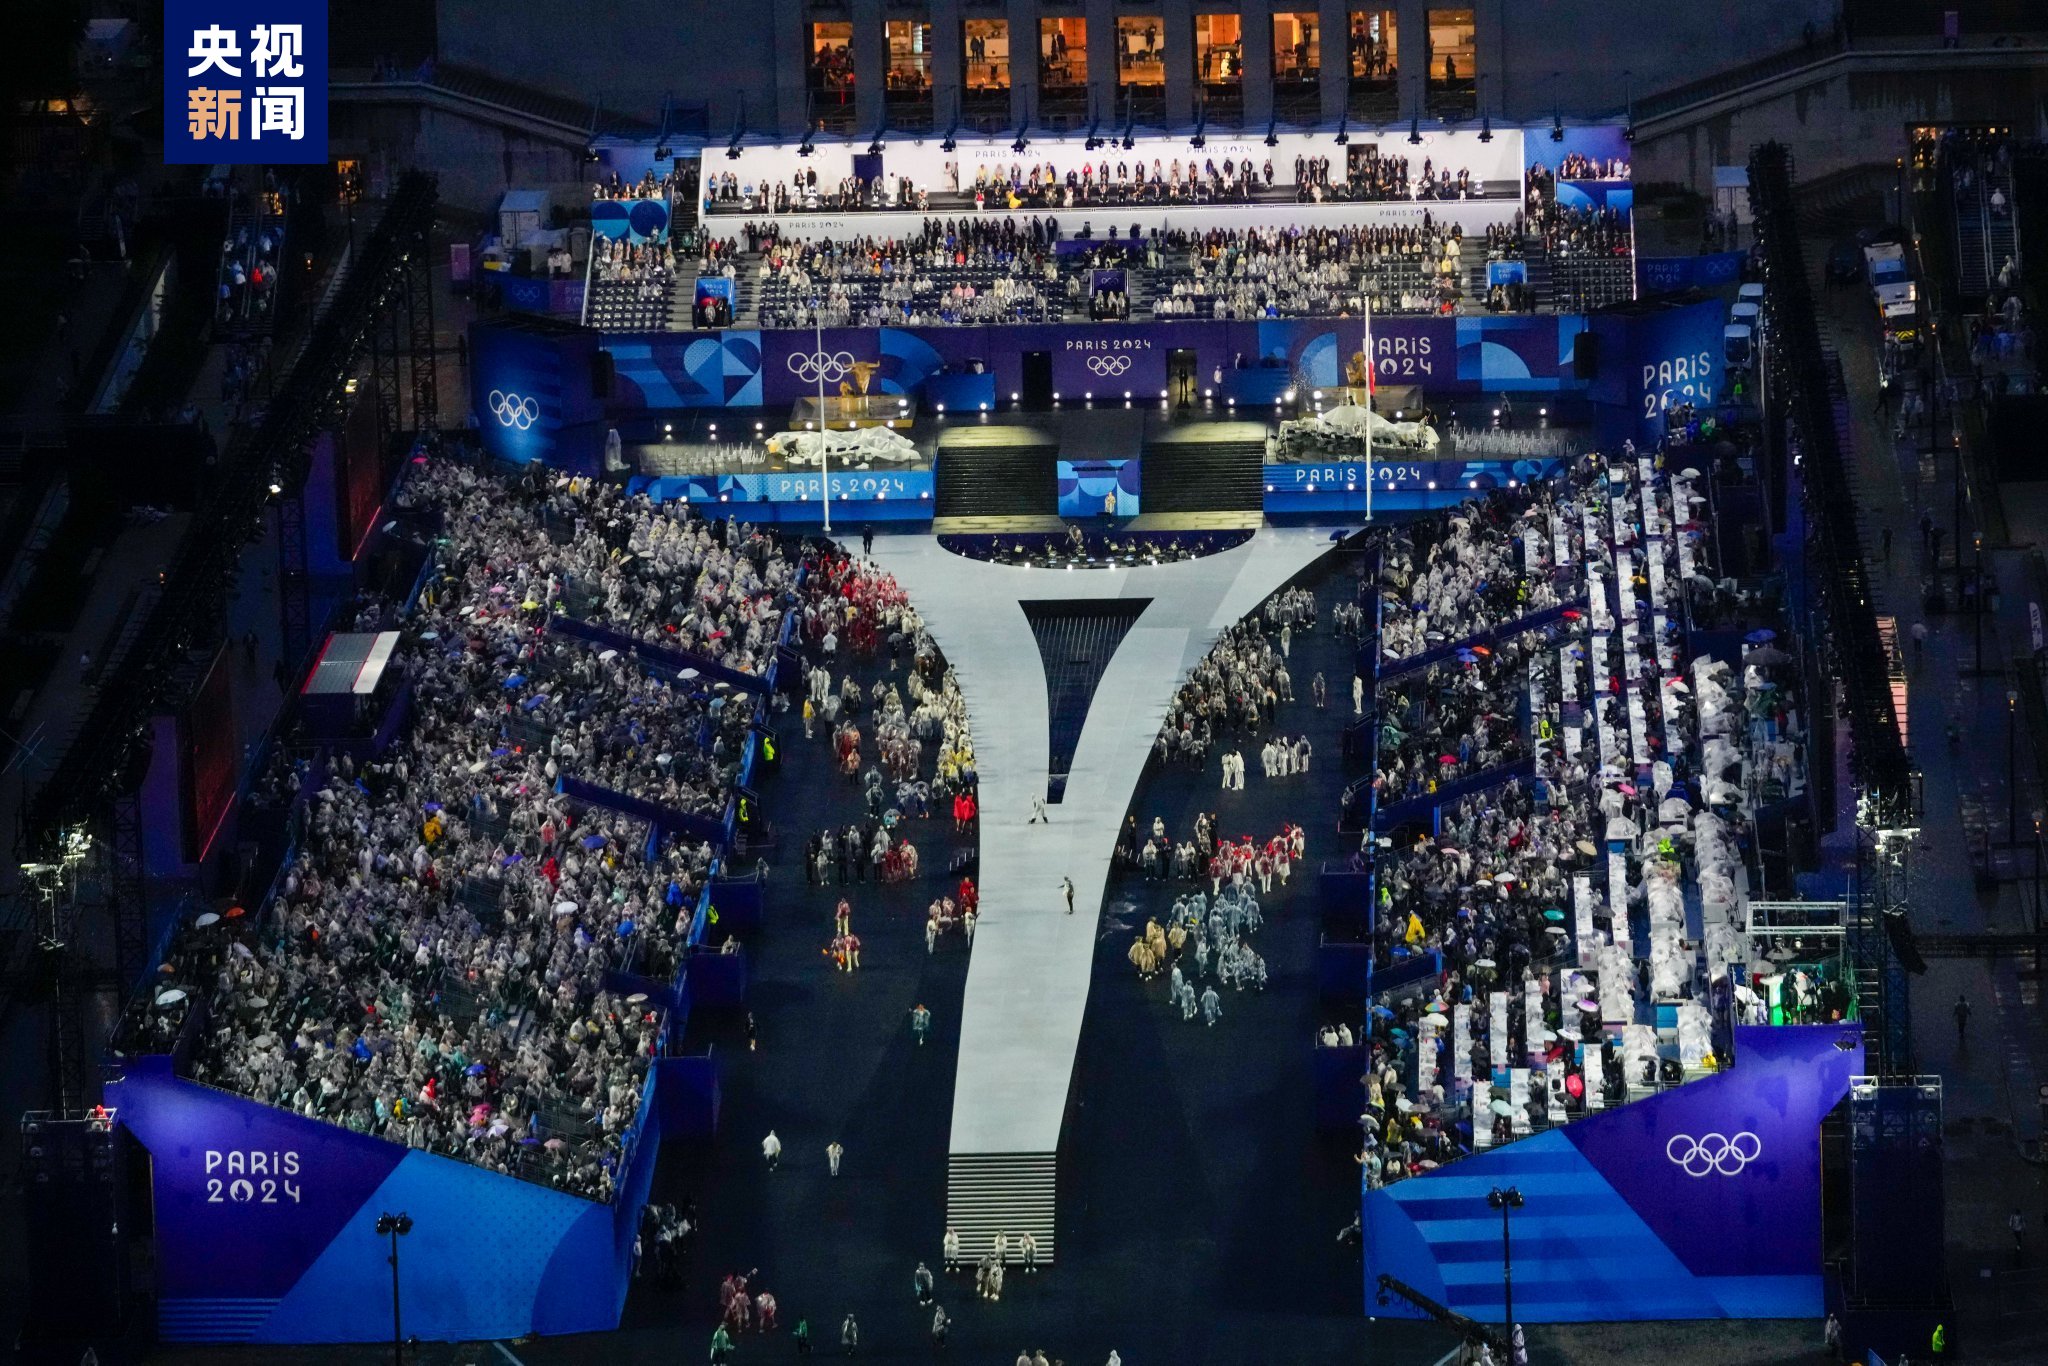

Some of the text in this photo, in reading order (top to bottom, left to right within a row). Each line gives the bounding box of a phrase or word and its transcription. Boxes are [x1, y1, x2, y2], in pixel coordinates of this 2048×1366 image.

[1113, 339, 1151, 349] 2024
[781, 478, 904, 493] PARS 2024
[206, 1179, 300, 1203] 2024
